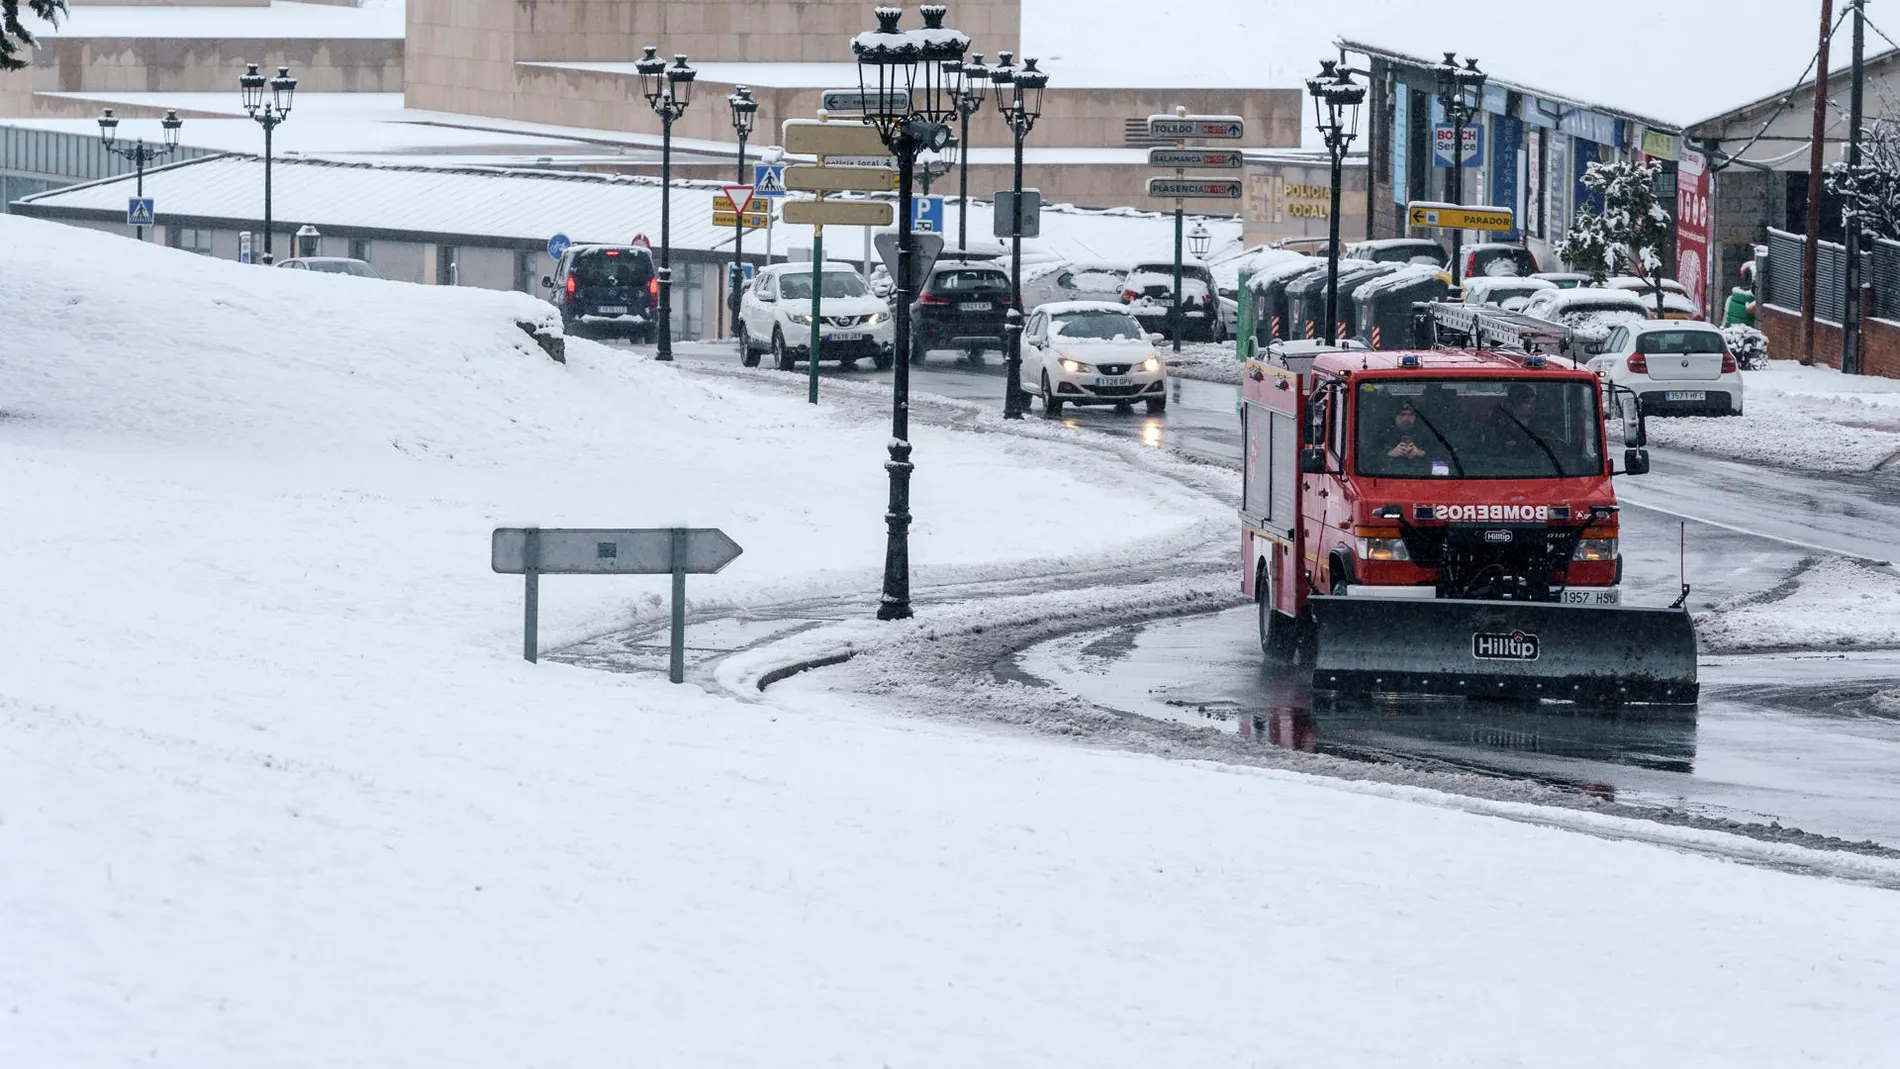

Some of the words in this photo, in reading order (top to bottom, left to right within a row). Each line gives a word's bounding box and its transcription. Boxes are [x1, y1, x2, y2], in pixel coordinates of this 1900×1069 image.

[1154, 124, 1192, 133] TOLEDO
[1437, 130, 1477, 141] BOCH
[1437, 141, 1476, 151] Serce
[858, 159, 880, 167] local
[1153, 155, 1202, 163] SALAMANCA
[1153, 184, 1203, 193] PLASENCIA
[917, 198, 931, 219] P
[1288, 203, 1327, 218] LOCAL
[1463, 215, 1510, 226] PARADOR
[1671, 392, 1688, 400] 3571
[1690, 392, 1704, 400] HFC
[1487, 531, 1511, 542] Hilltip
[1563, 592, 1590, 604] 1957
[1478, 636, 1535, 659] Hilltip
